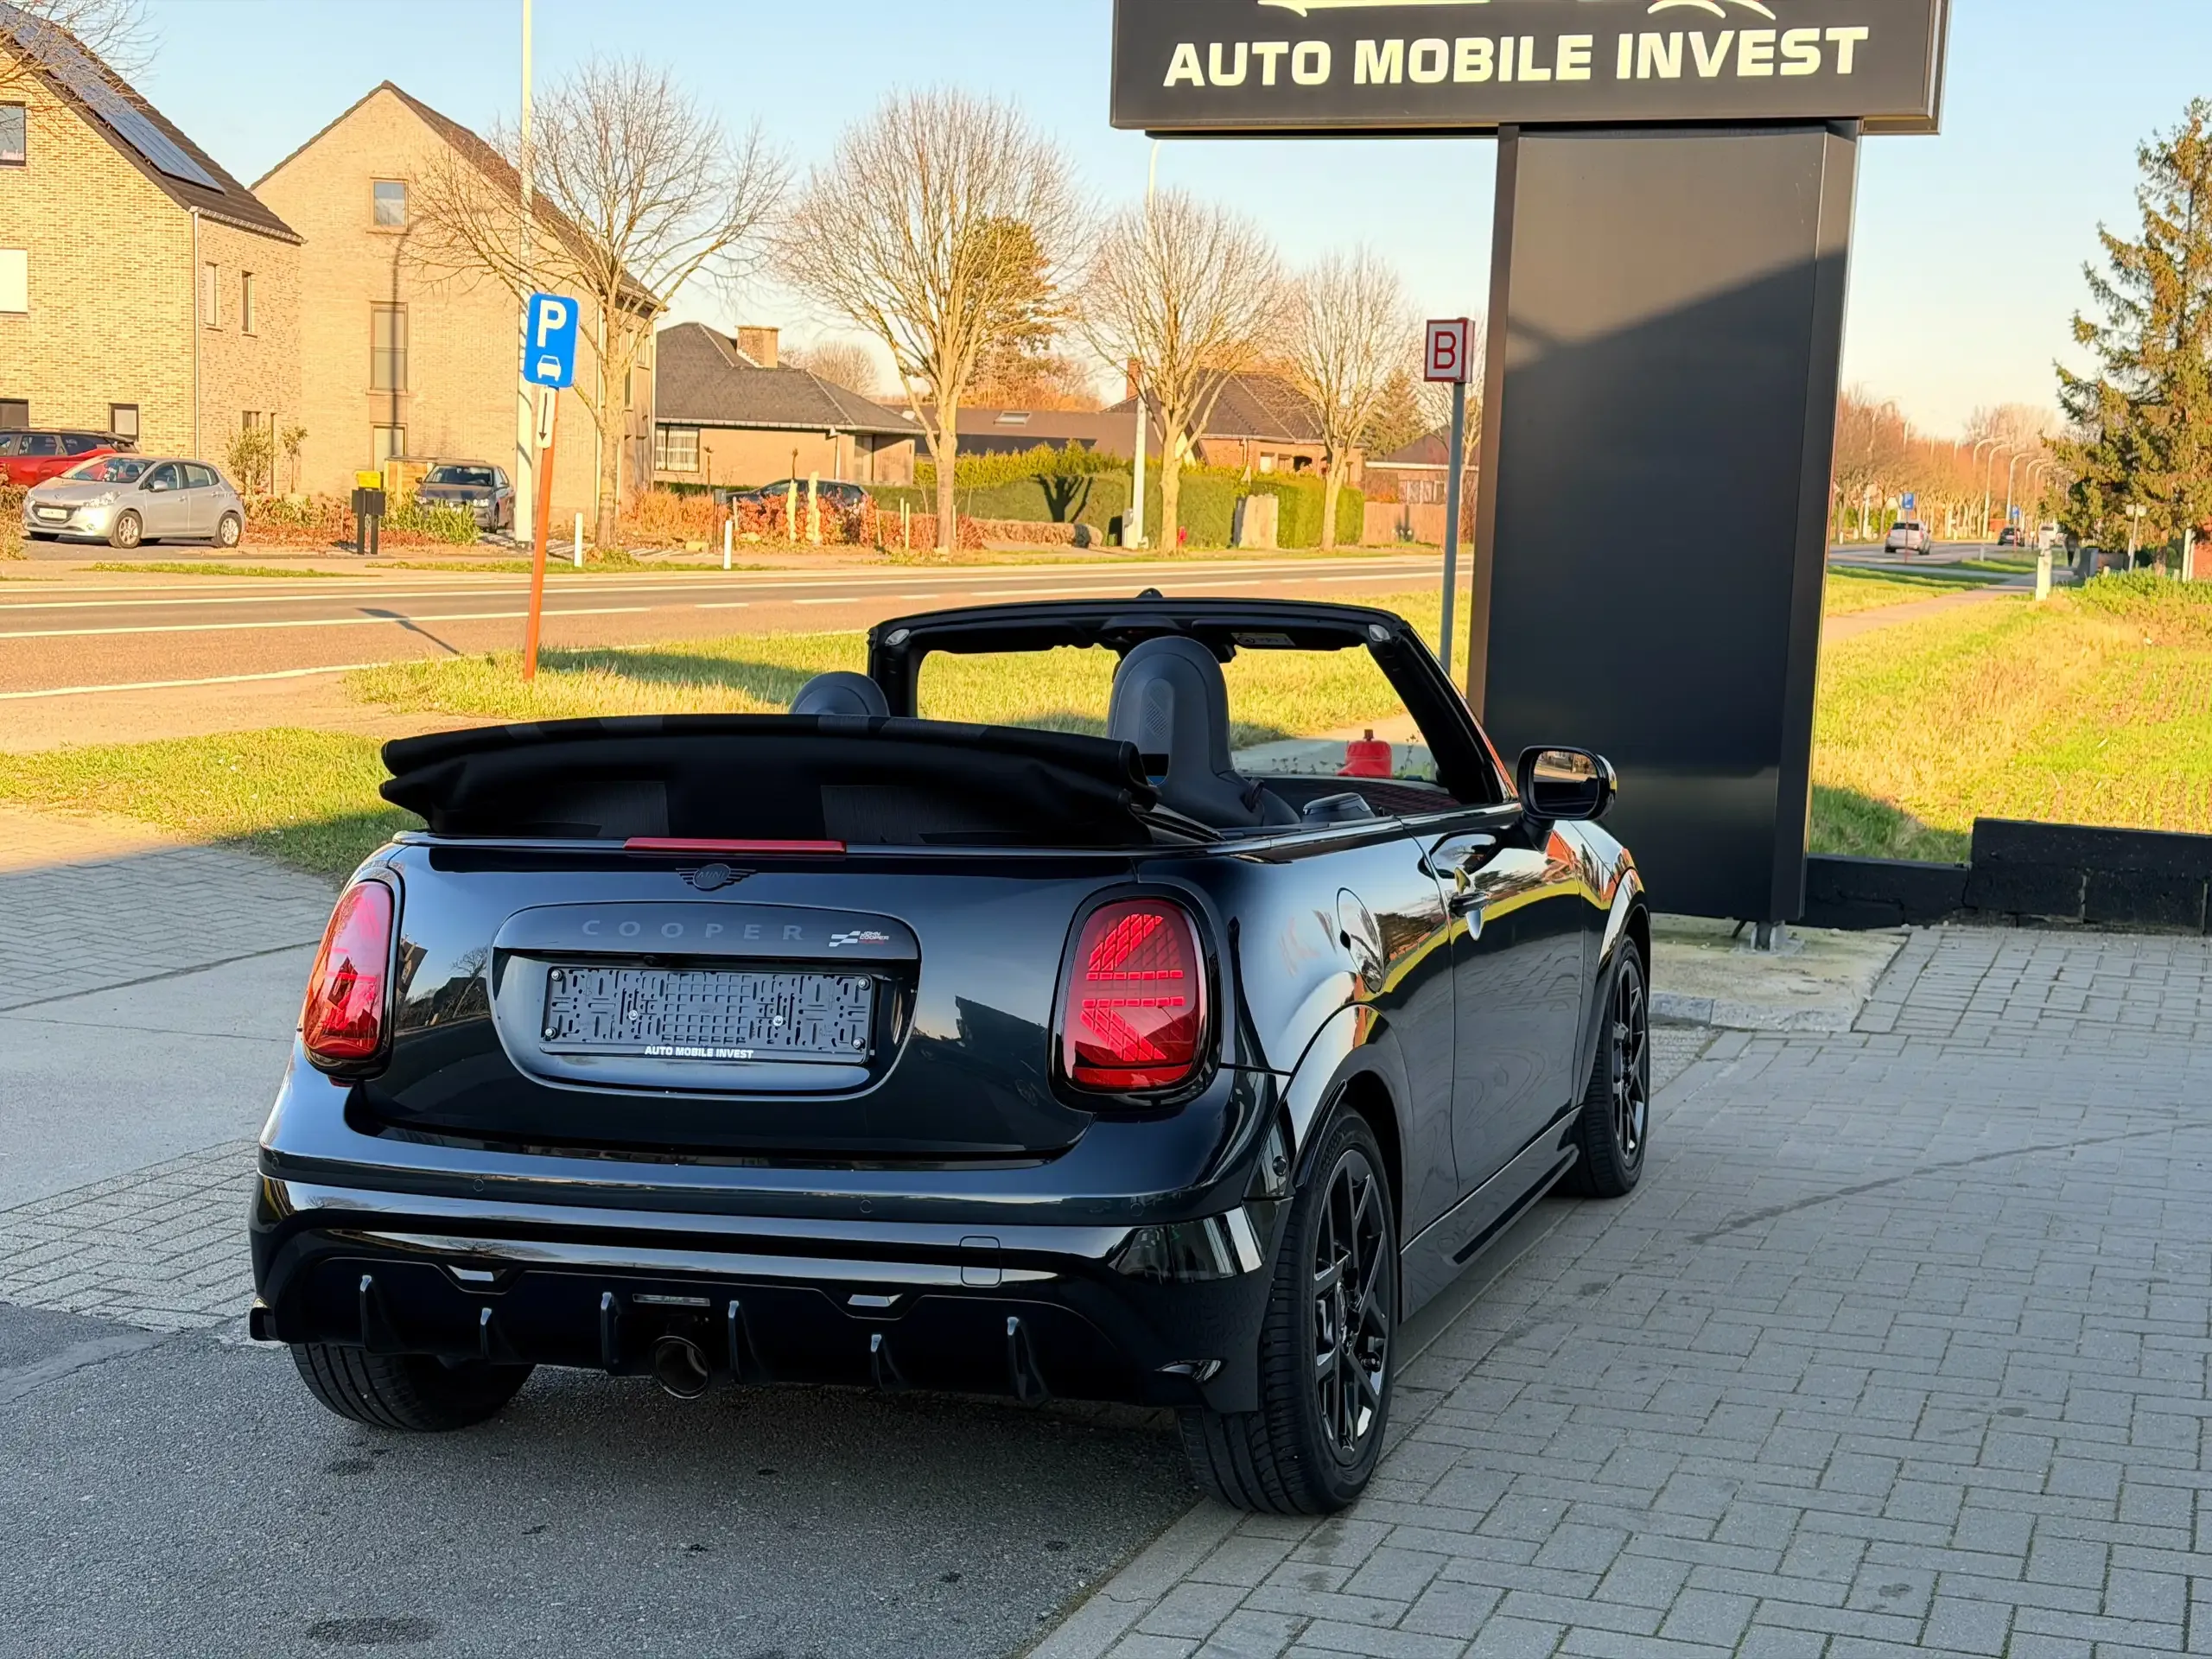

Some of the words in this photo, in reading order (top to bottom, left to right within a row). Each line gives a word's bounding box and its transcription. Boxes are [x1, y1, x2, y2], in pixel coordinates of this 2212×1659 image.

[1163, 41, 1332, 86] AUTO
[1353, 35, 1593, 85] MOBILE
[1616, 27, 1869, 79] INVEST
[537, 299, 567, 348] P
[1433, 331, 1457, 370] B
[698, 870, 726, 879] MINI
[582, 919, 804, 941] COOPER
[645, 1046, 673, 1055] AUTO
[675, 1046, 714, 1057] MOBILE
[715, 1048, 754, 1059] INVEST
